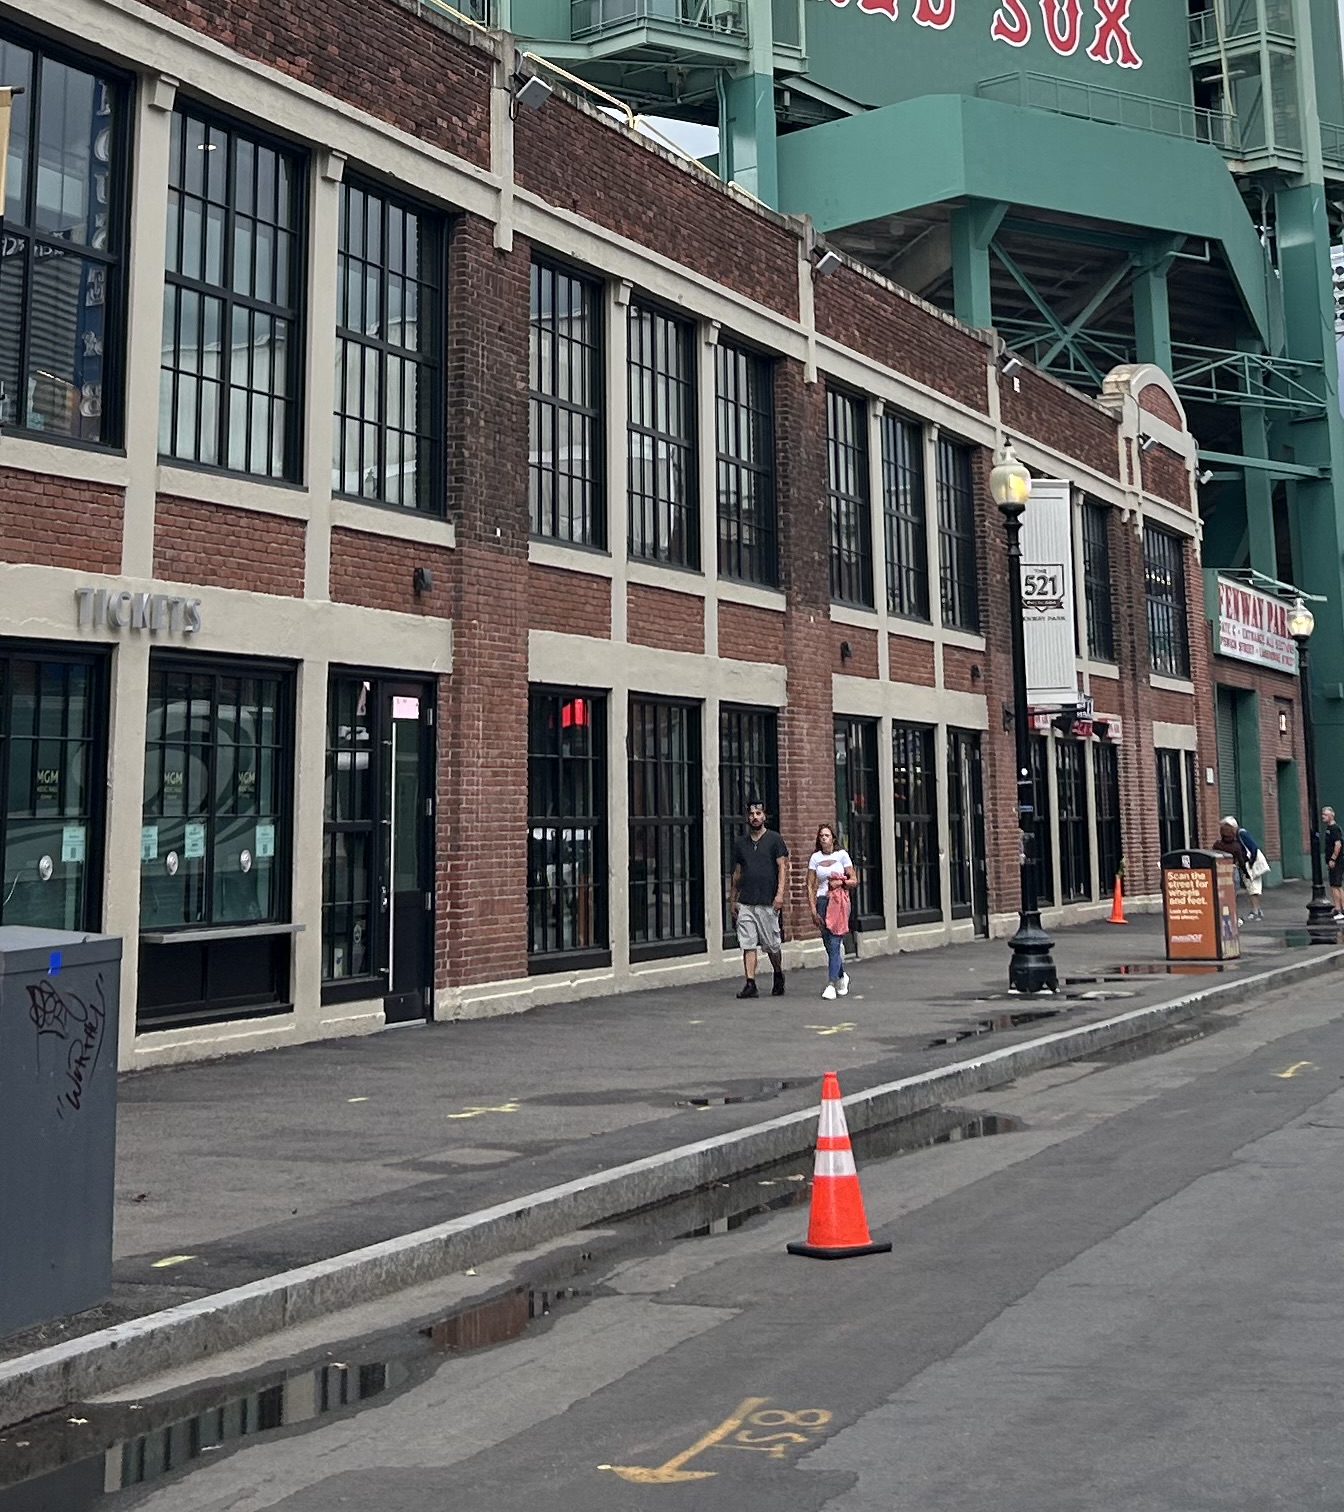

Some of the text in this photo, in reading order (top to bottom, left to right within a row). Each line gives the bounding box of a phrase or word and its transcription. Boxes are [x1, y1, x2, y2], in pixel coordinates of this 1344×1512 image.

[1024, 575, 1057, 596] 521
[74, 587, 202, 633] TICKETS
[37, 770, 59, 784] MGM
[1167, 872, 1206, 880] Scan the
[1168, 880, 1209, 889] street for
[1170, 897, 1186, 906] and
